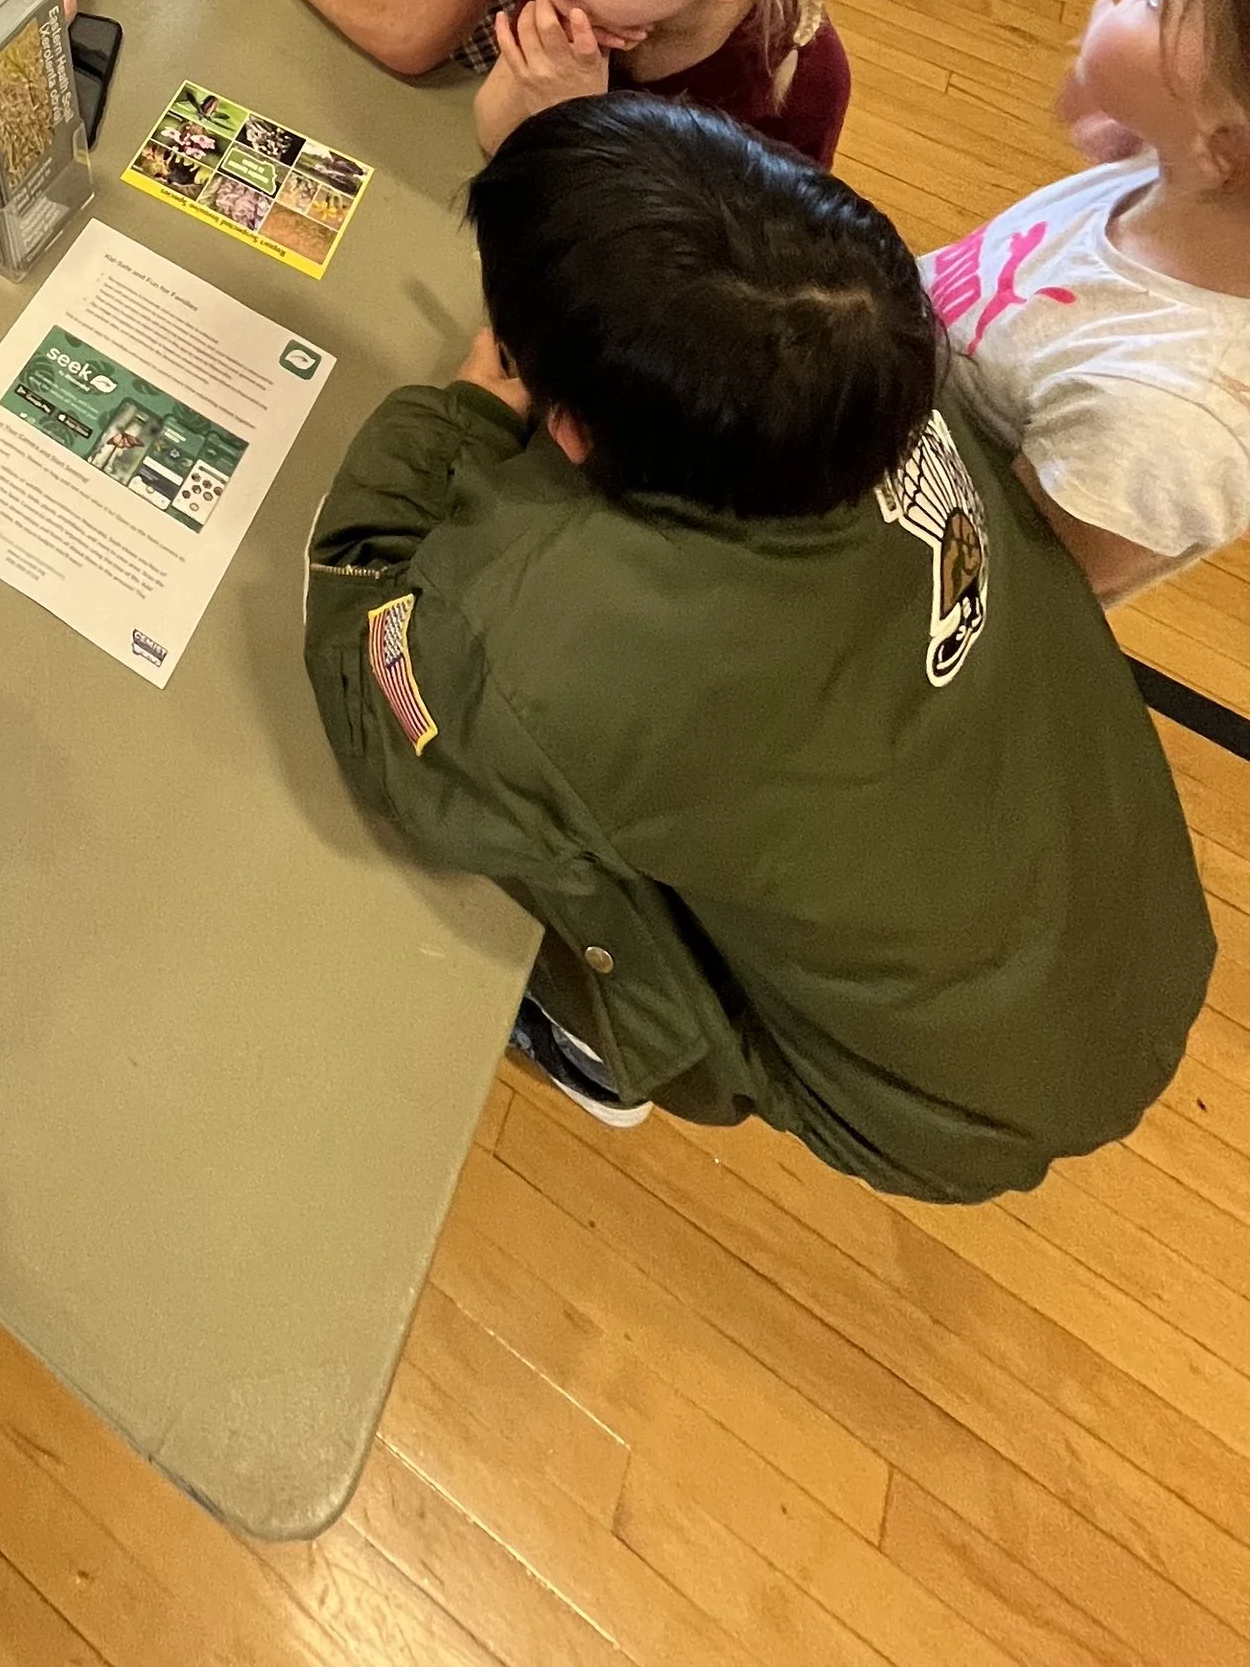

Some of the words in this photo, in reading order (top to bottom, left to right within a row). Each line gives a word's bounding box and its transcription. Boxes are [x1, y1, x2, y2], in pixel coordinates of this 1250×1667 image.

[49, 5, 64, 55] Eastern
[56, 53, 69, 94] Heath
[61, 91, 74, 124] Snail
[160, 187, 188, 207] Species
[188, 203, 220, 222] Invasive
[219, 220, 259, 244] Suspected
[260, 240, 287, 258] Report
[104, 253, 133, 272] Kid-Safe
[132, 270, 147, 281] and
[146, 277, 159, 288] Fun
[170, 291, 198, 311] Families
[46, 347, 93, 382] seek
